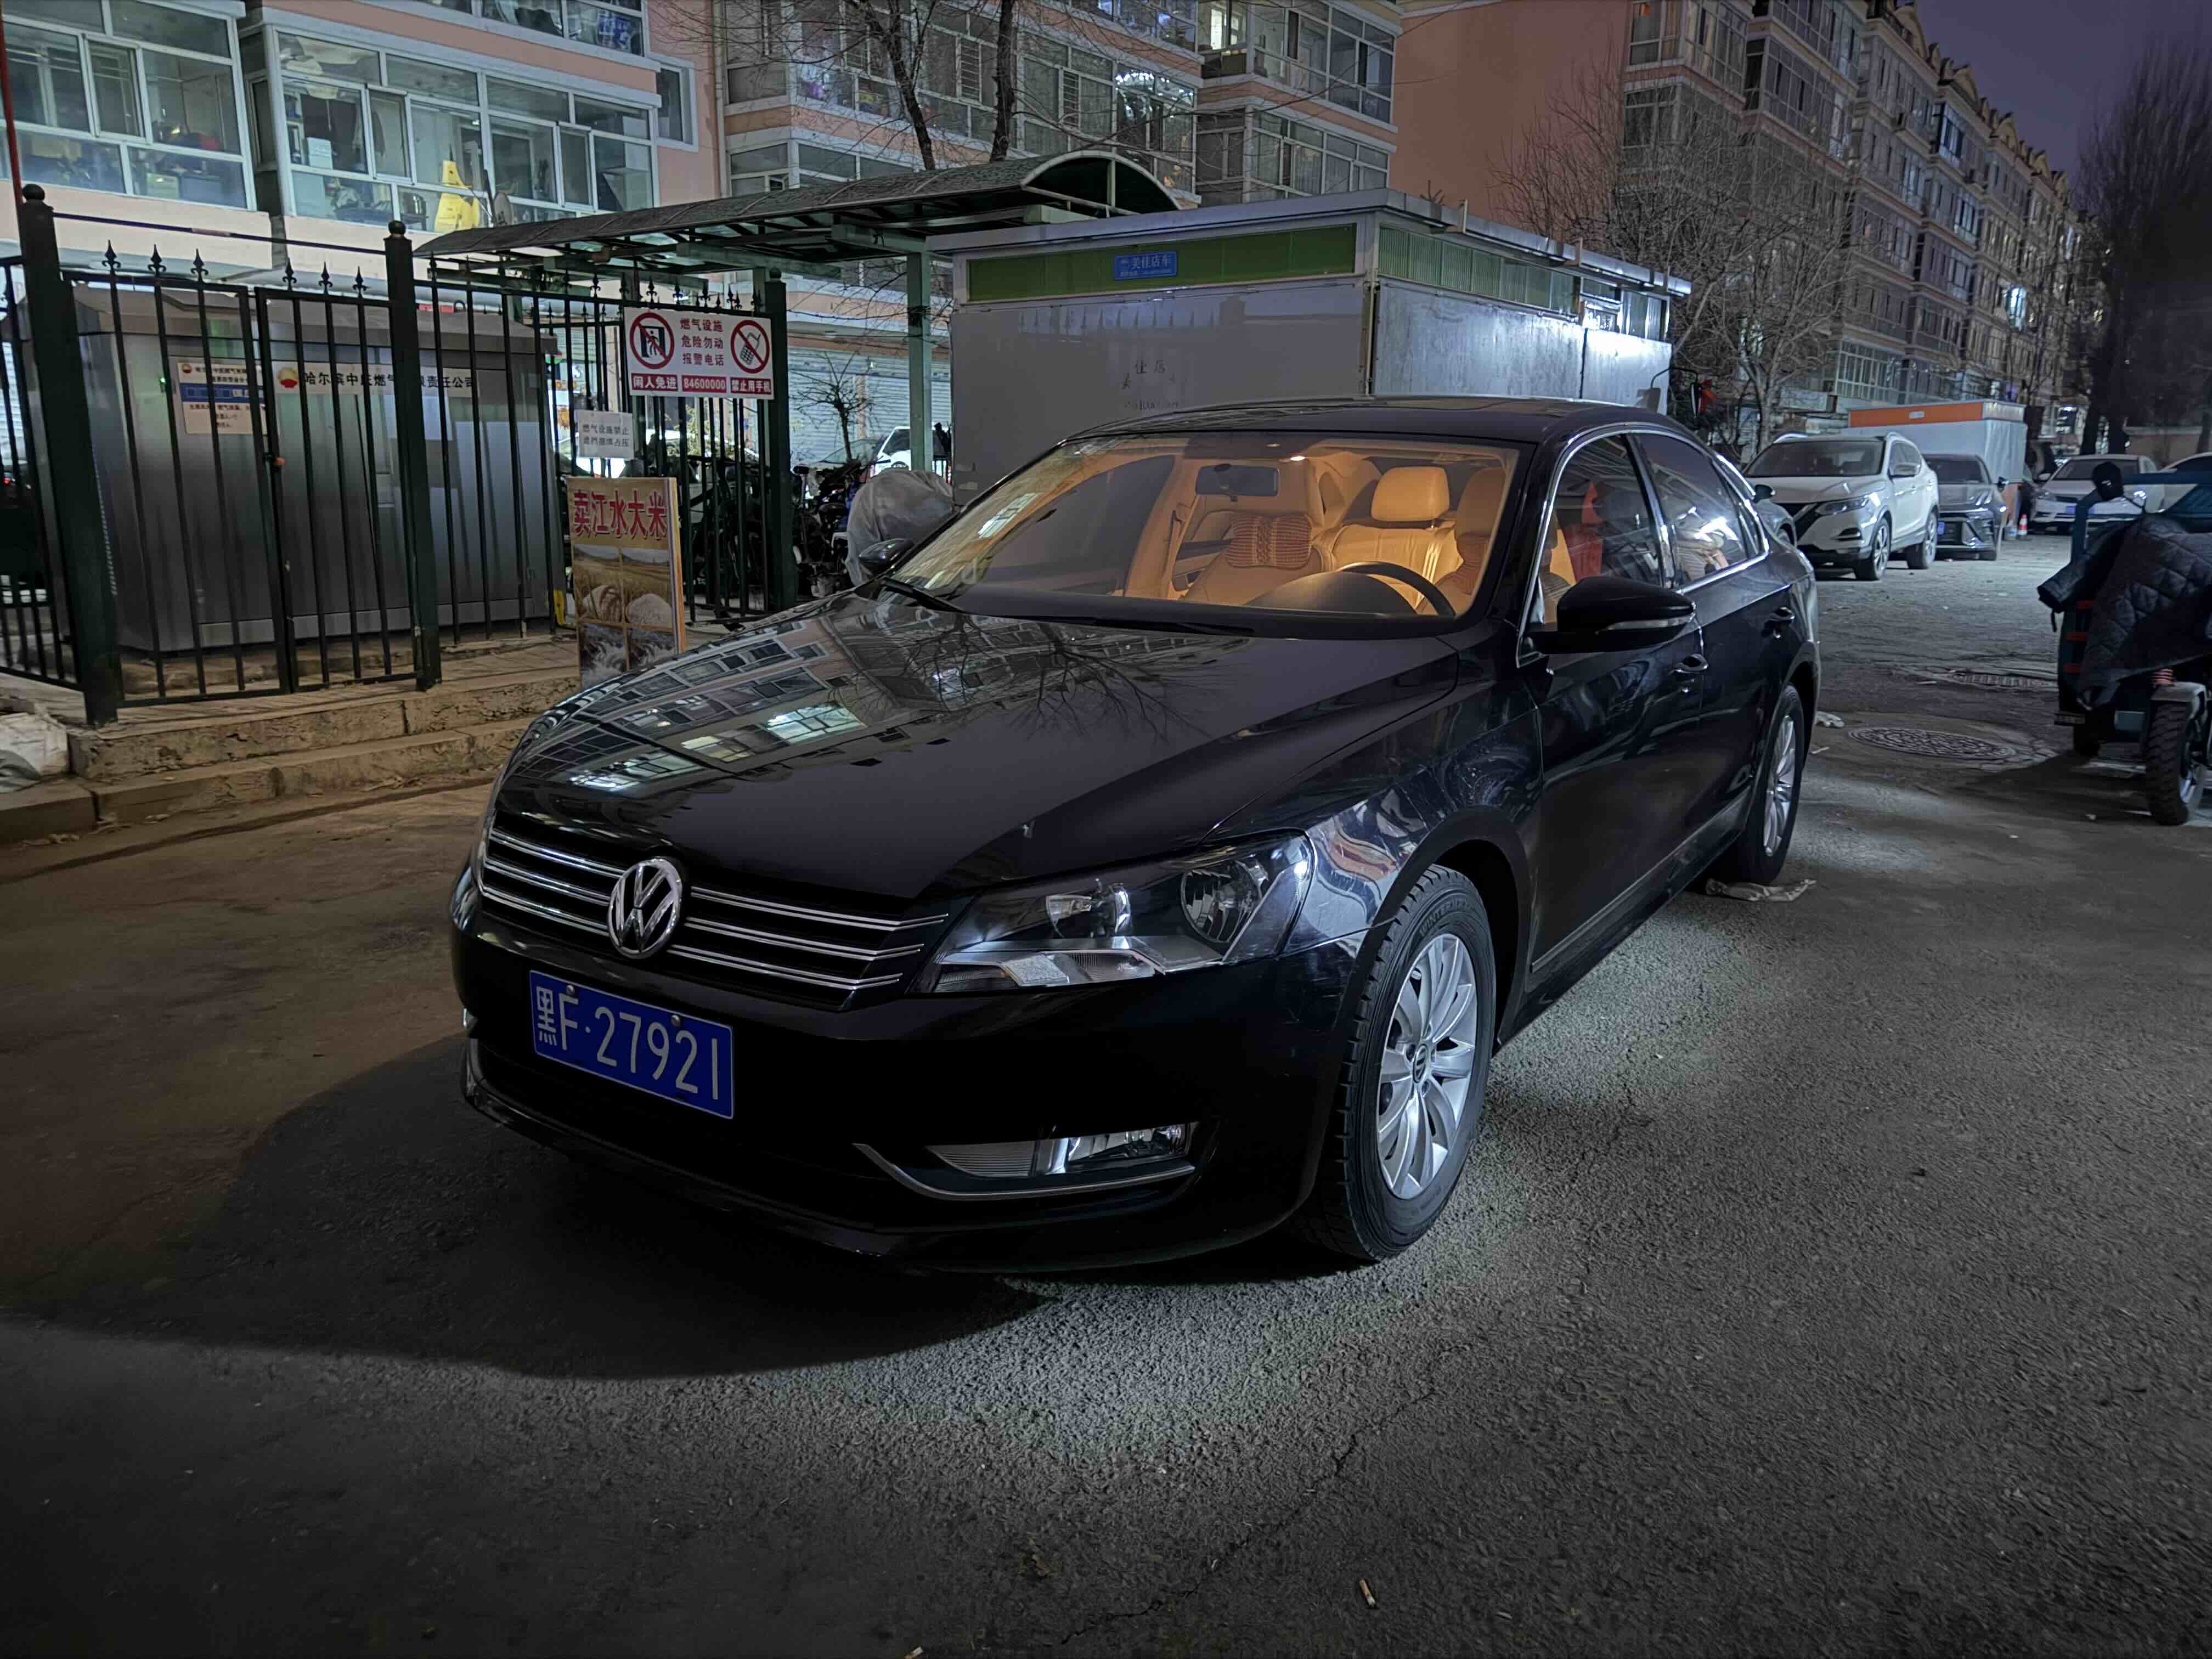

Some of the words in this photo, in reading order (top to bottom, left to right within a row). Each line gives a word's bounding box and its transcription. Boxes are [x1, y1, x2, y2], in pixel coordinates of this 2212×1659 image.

[680, 316, 724, 332] 燃气设施
[681, 334, 724, 349] 危险勿动
[682, 352, 724, 366] 报警电话
[633, 376, 677, 389] 闲人免进
[683, 377, 725, 390] 84600000
[731, 380, 772, 393] 禁止用手机
[573, 489, 668, 540] 卖江水大米
[535, 986, 719, 1101] 黑F·27921
